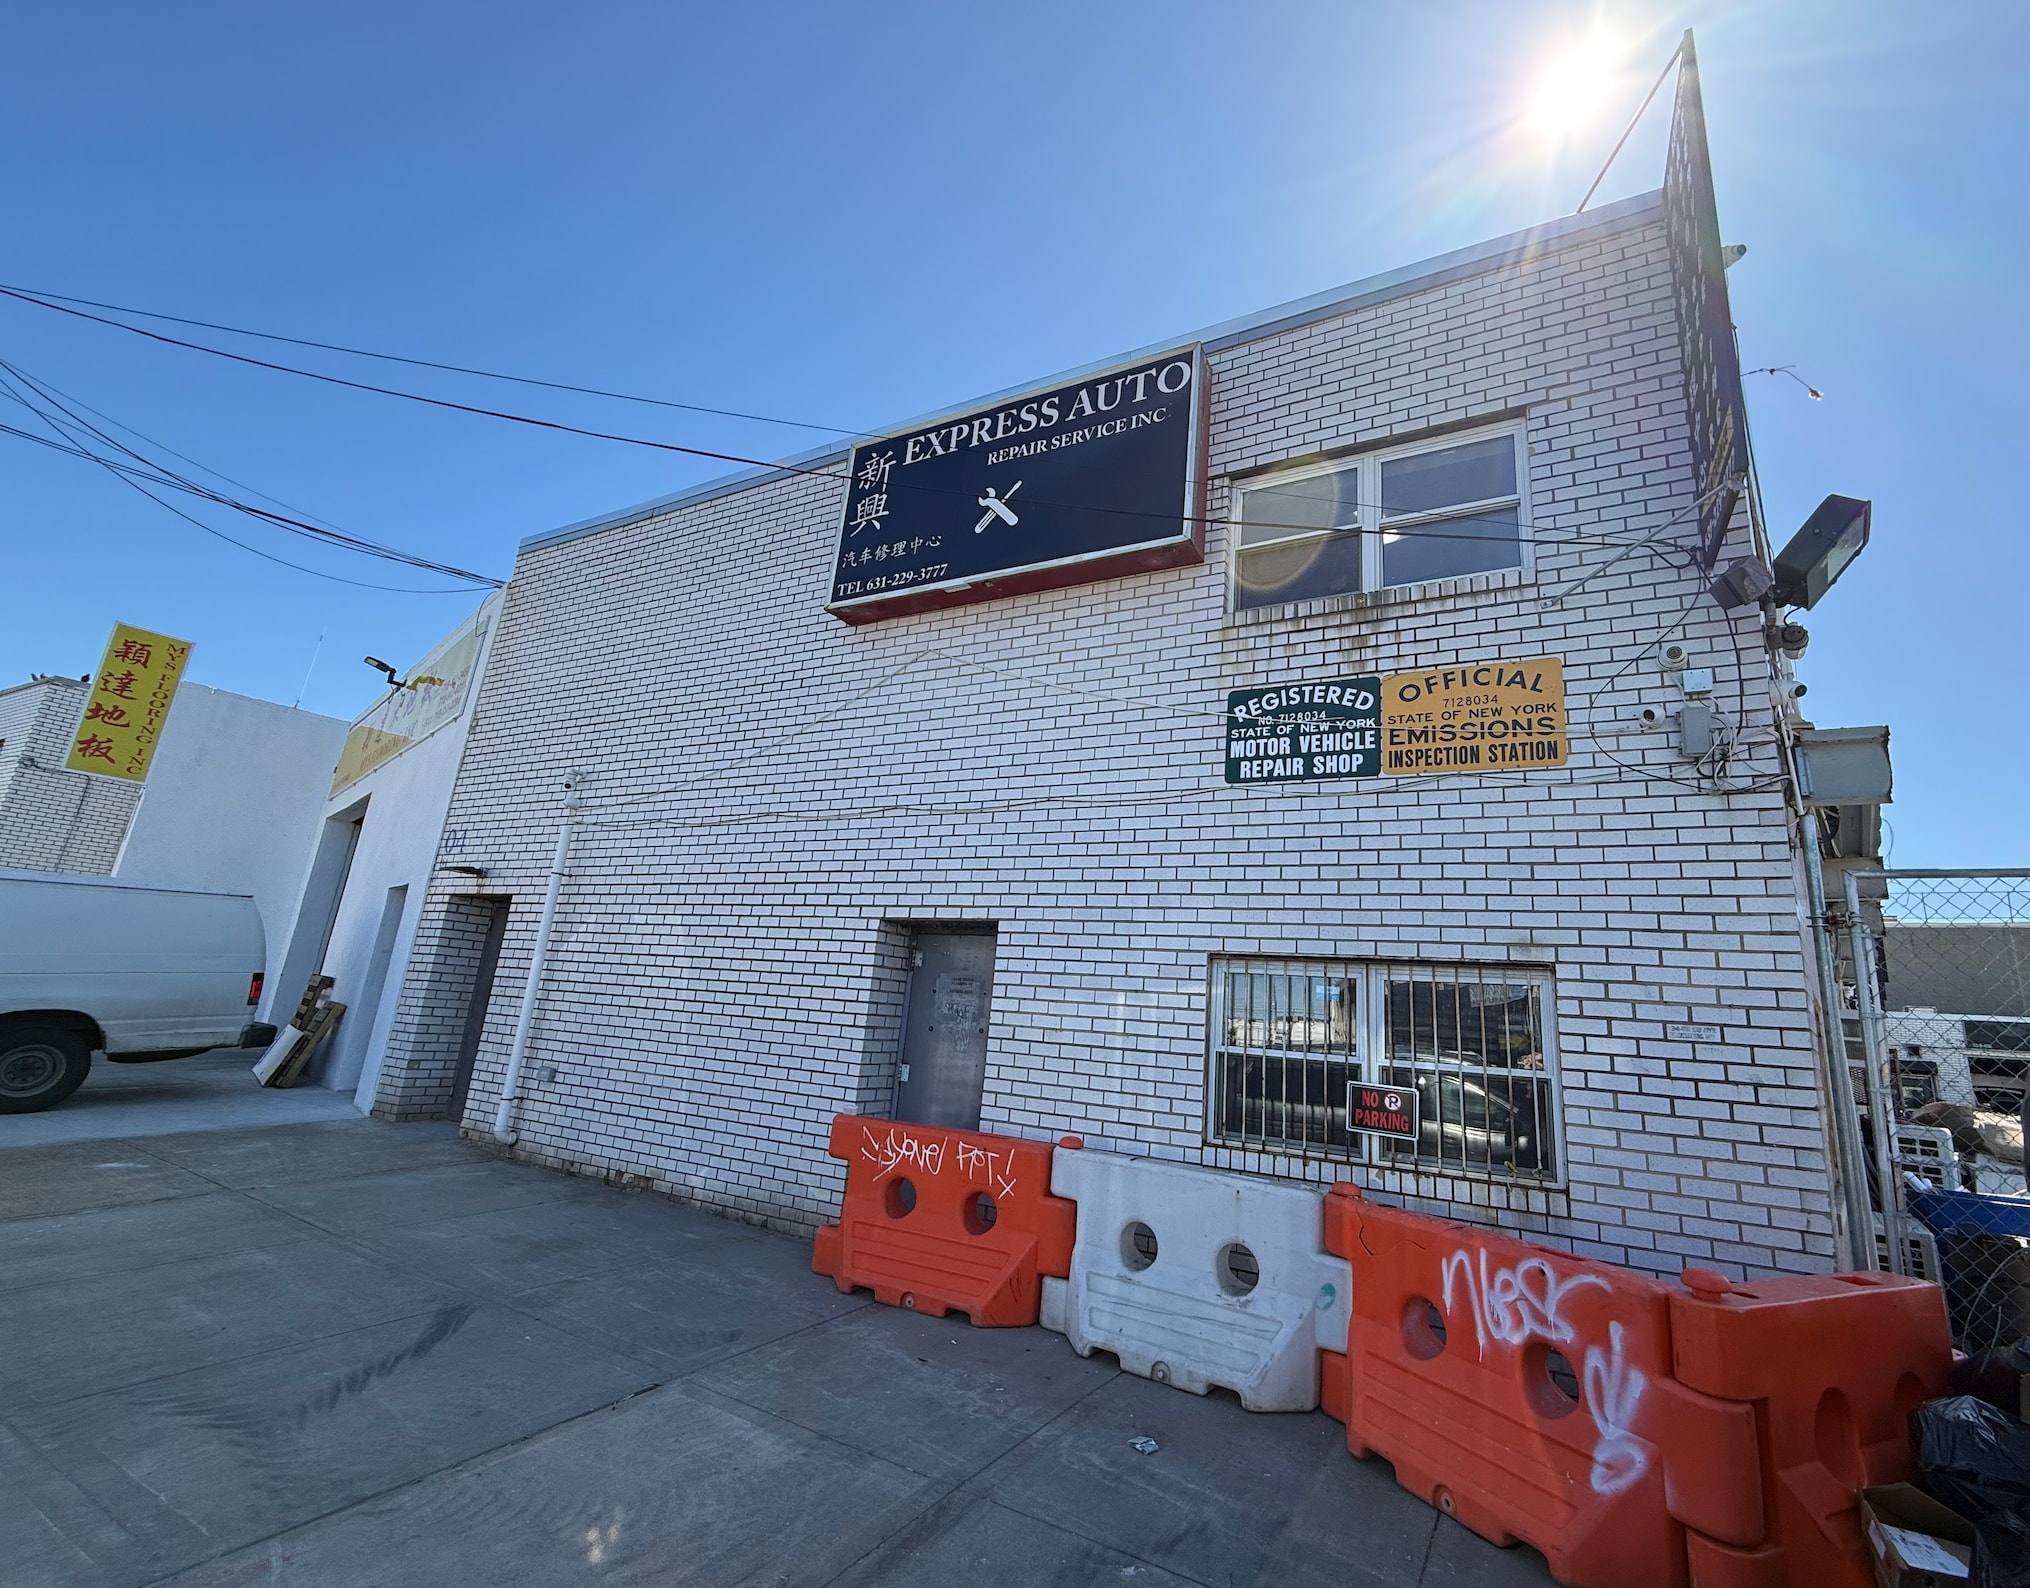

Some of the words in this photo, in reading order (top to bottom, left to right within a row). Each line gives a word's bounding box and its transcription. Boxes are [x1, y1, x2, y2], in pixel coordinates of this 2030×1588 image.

[902, 399, 1060, 466] EXPRESS
[1065, 360, 1192, 422] AUTO
[987, 437, 1048, 466] REPAIR
[1050, 418, 1127, 451] SERVICE
[1130, 408, 1168, 430] INC
[848, 451, 897, 537] 新興
[841, 534, 942, 569] 汽车修理中心
[837, 580, 864, 597] TEL
[866, 563, 949, 592] 631-229-3777
[163, 644, 187, 671] MYS
[1398, 667, 1545, 703] OFFICIAL
[136, 674, 171, 744] FLOORING
[1234, 685, 1375, 722] REGISTERED
[1388, 712, 1433, 725] STATE
[1441, 710, 1462, 721] OF
[1466, 706, 1503, 720] NEW
[1510, 701, 1558, 715] YORK
[1443, 694, 1498, 708] 7128034
[1231, 726, 1273, 739] STATE
[1277, 725, 1295, 736] OF
[1300, 722, 1330, 734] NEW
[1336, 718, 1376, 730] YORK
[1279, 710, 1326, 723] 7128034
[1389, 716, 1556, 746] EMISSIONS
[1230, 737, 1290, 759] MOTOR
[1299, 730, 1376, 754] VEHICLE
[1388, 744, 1481, 769] INSPECTION
[1488, 740, 1558, 763] STATION
[126, 748, 146, 775] INC
[1240, 757, 1304, 779] REPAIR
[1312, 754, 1364, 775] SHOP
[1362, 1090, 1378, 1107] NO
[1355, 1109, 1408, 1131] PARKING
